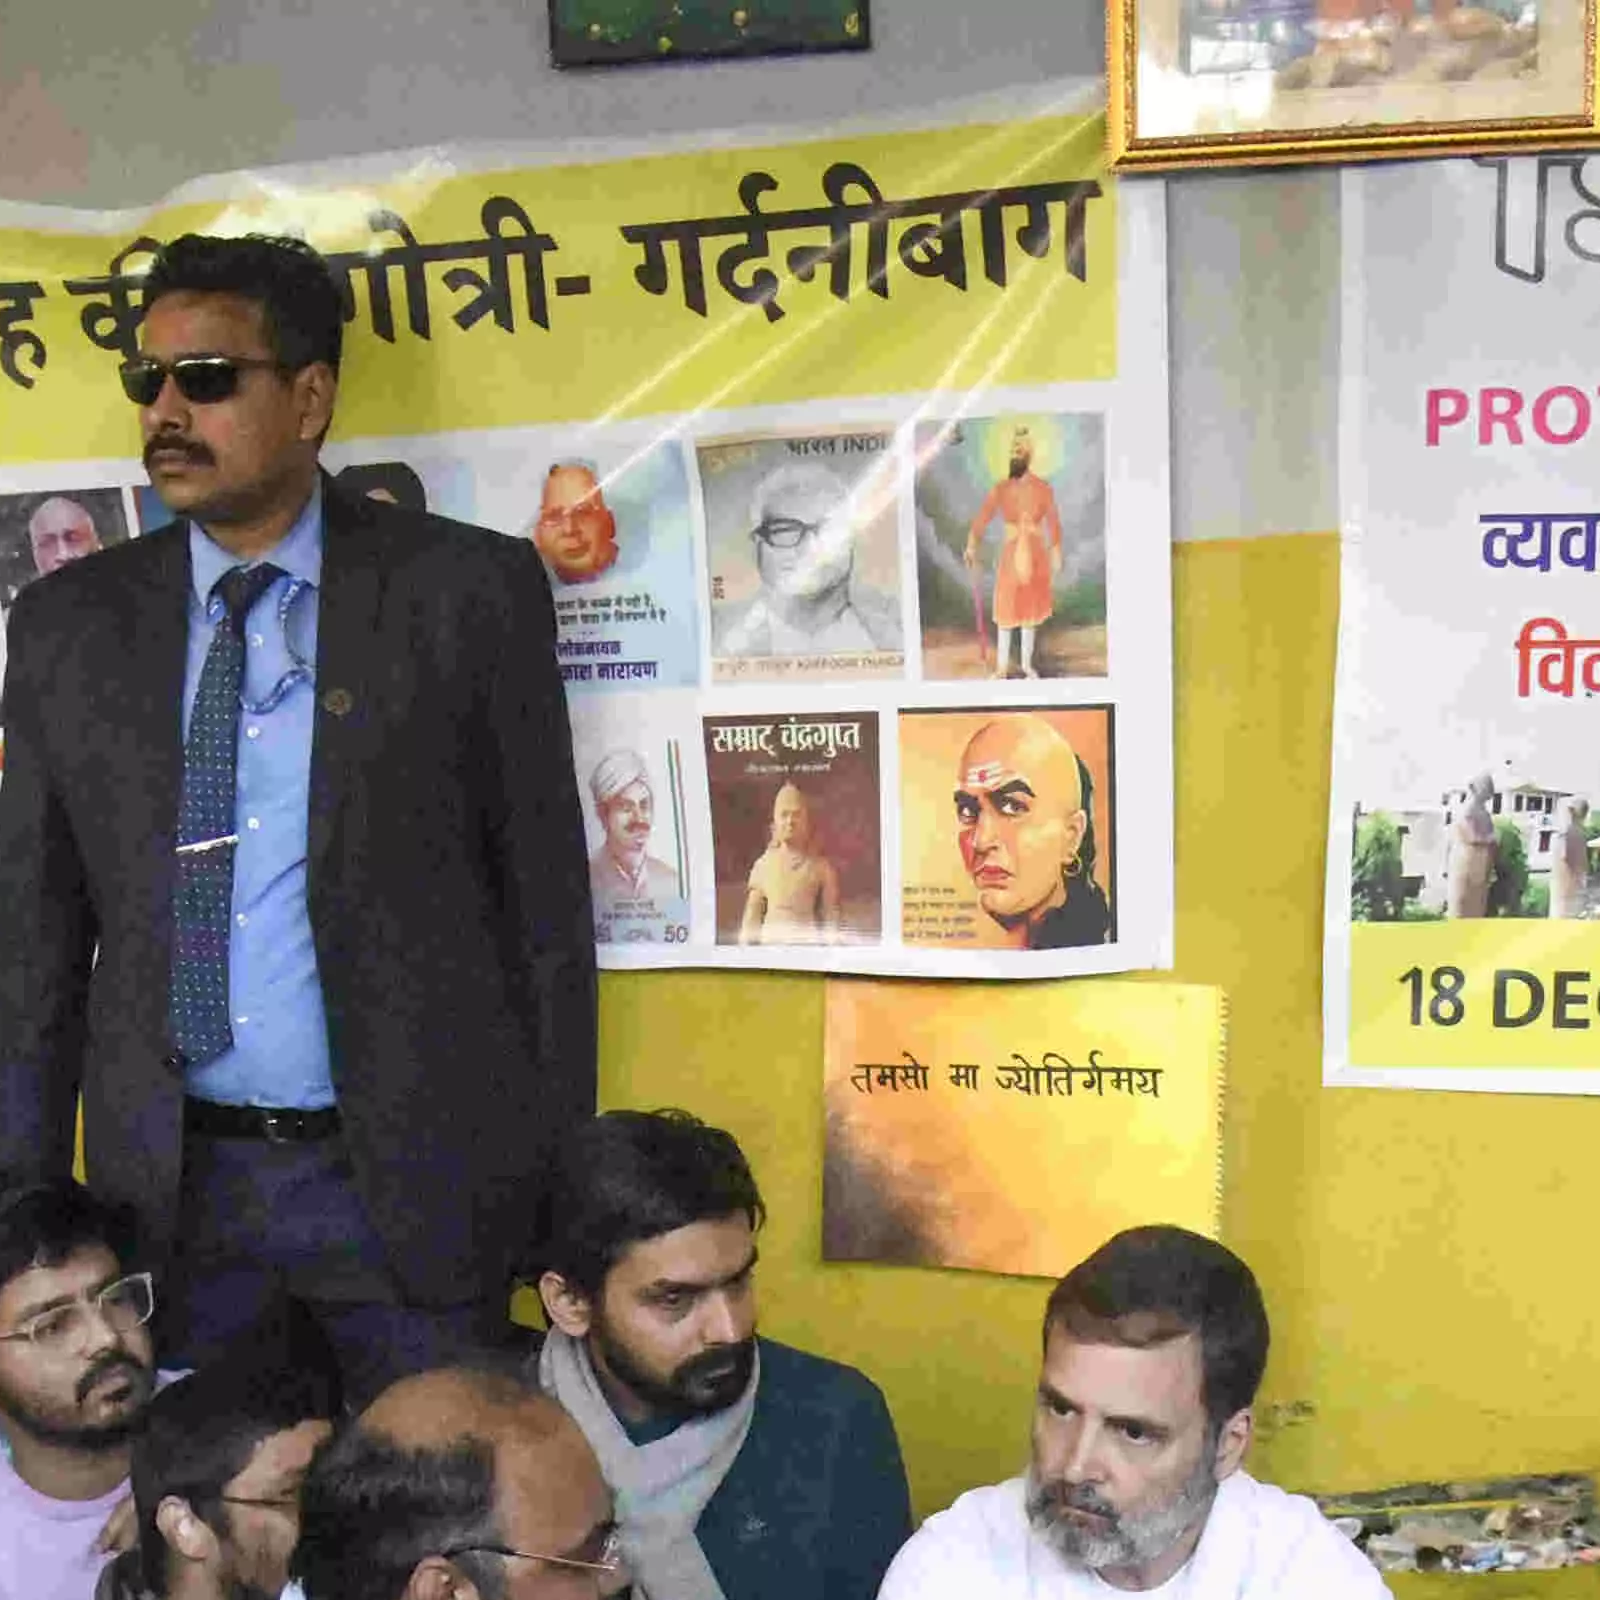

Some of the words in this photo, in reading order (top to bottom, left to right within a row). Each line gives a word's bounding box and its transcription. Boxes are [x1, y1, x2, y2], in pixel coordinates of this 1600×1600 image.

[63, 236, 160, 360] क
[621, 161, 1103, 322] गर्दनीबाग
[843, 434, 888, 454] INDI
[778, 716, 862, 758] चंद्रगुप्त
[1398, 966, 1465, 1026] 18
[851, 1051, 929, 1093] तमसो
[949, 1064, 979, 1091] मा
